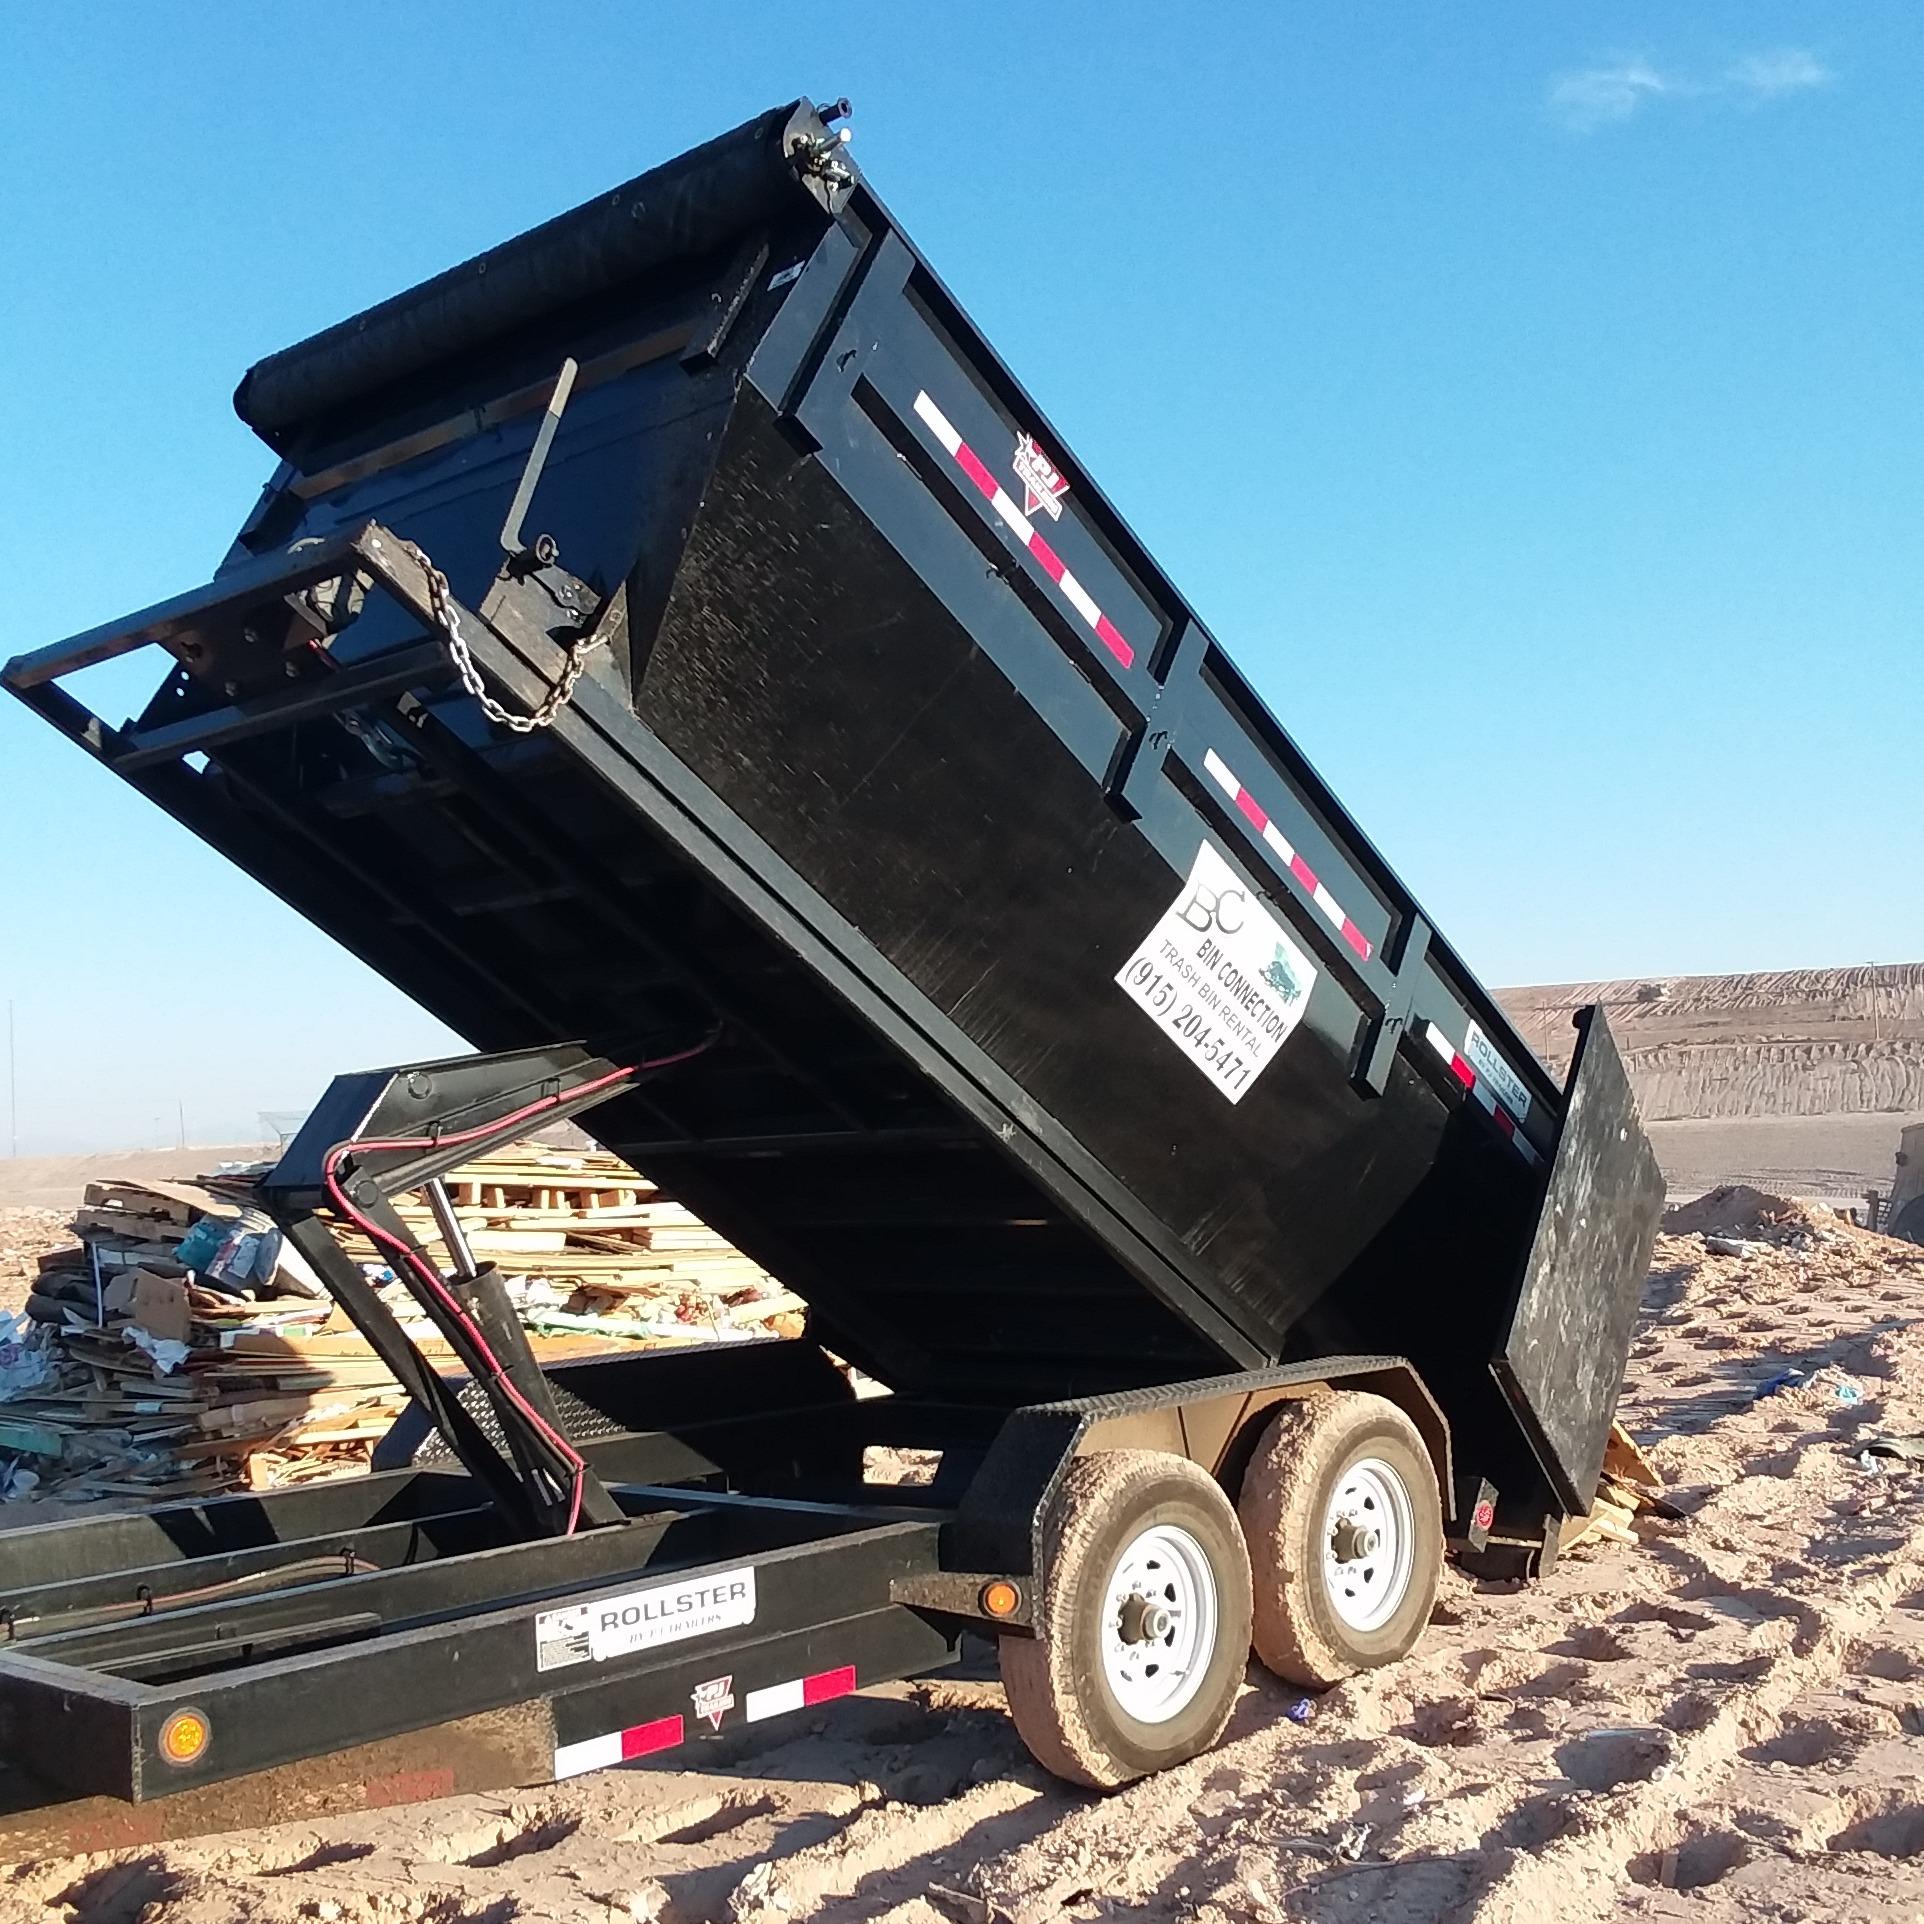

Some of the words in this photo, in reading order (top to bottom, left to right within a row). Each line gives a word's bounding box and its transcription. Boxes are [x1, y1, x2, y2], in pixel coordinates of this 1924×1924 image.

[1030, 454, 1060, 489] PJ
[1175, 882, 1246, 935] BC
[1124, 956, 1178, 1017] (915)
[1171, 1003, 1251, 1090] 204-5471
[1159, 938, 1202, 988] TRASH
[1197, 982, 1221, 1011] BIN
[1218, 1005, 1263, 1058] RENTAL
[1196, 937, 1224, 971] BIN
[1217, 961, 1289, 1043] CONNECTION
[1471, 1030, 1528, 1108] ROLLSTER
[600, 1581, 747, 1633] ROLLSTER
